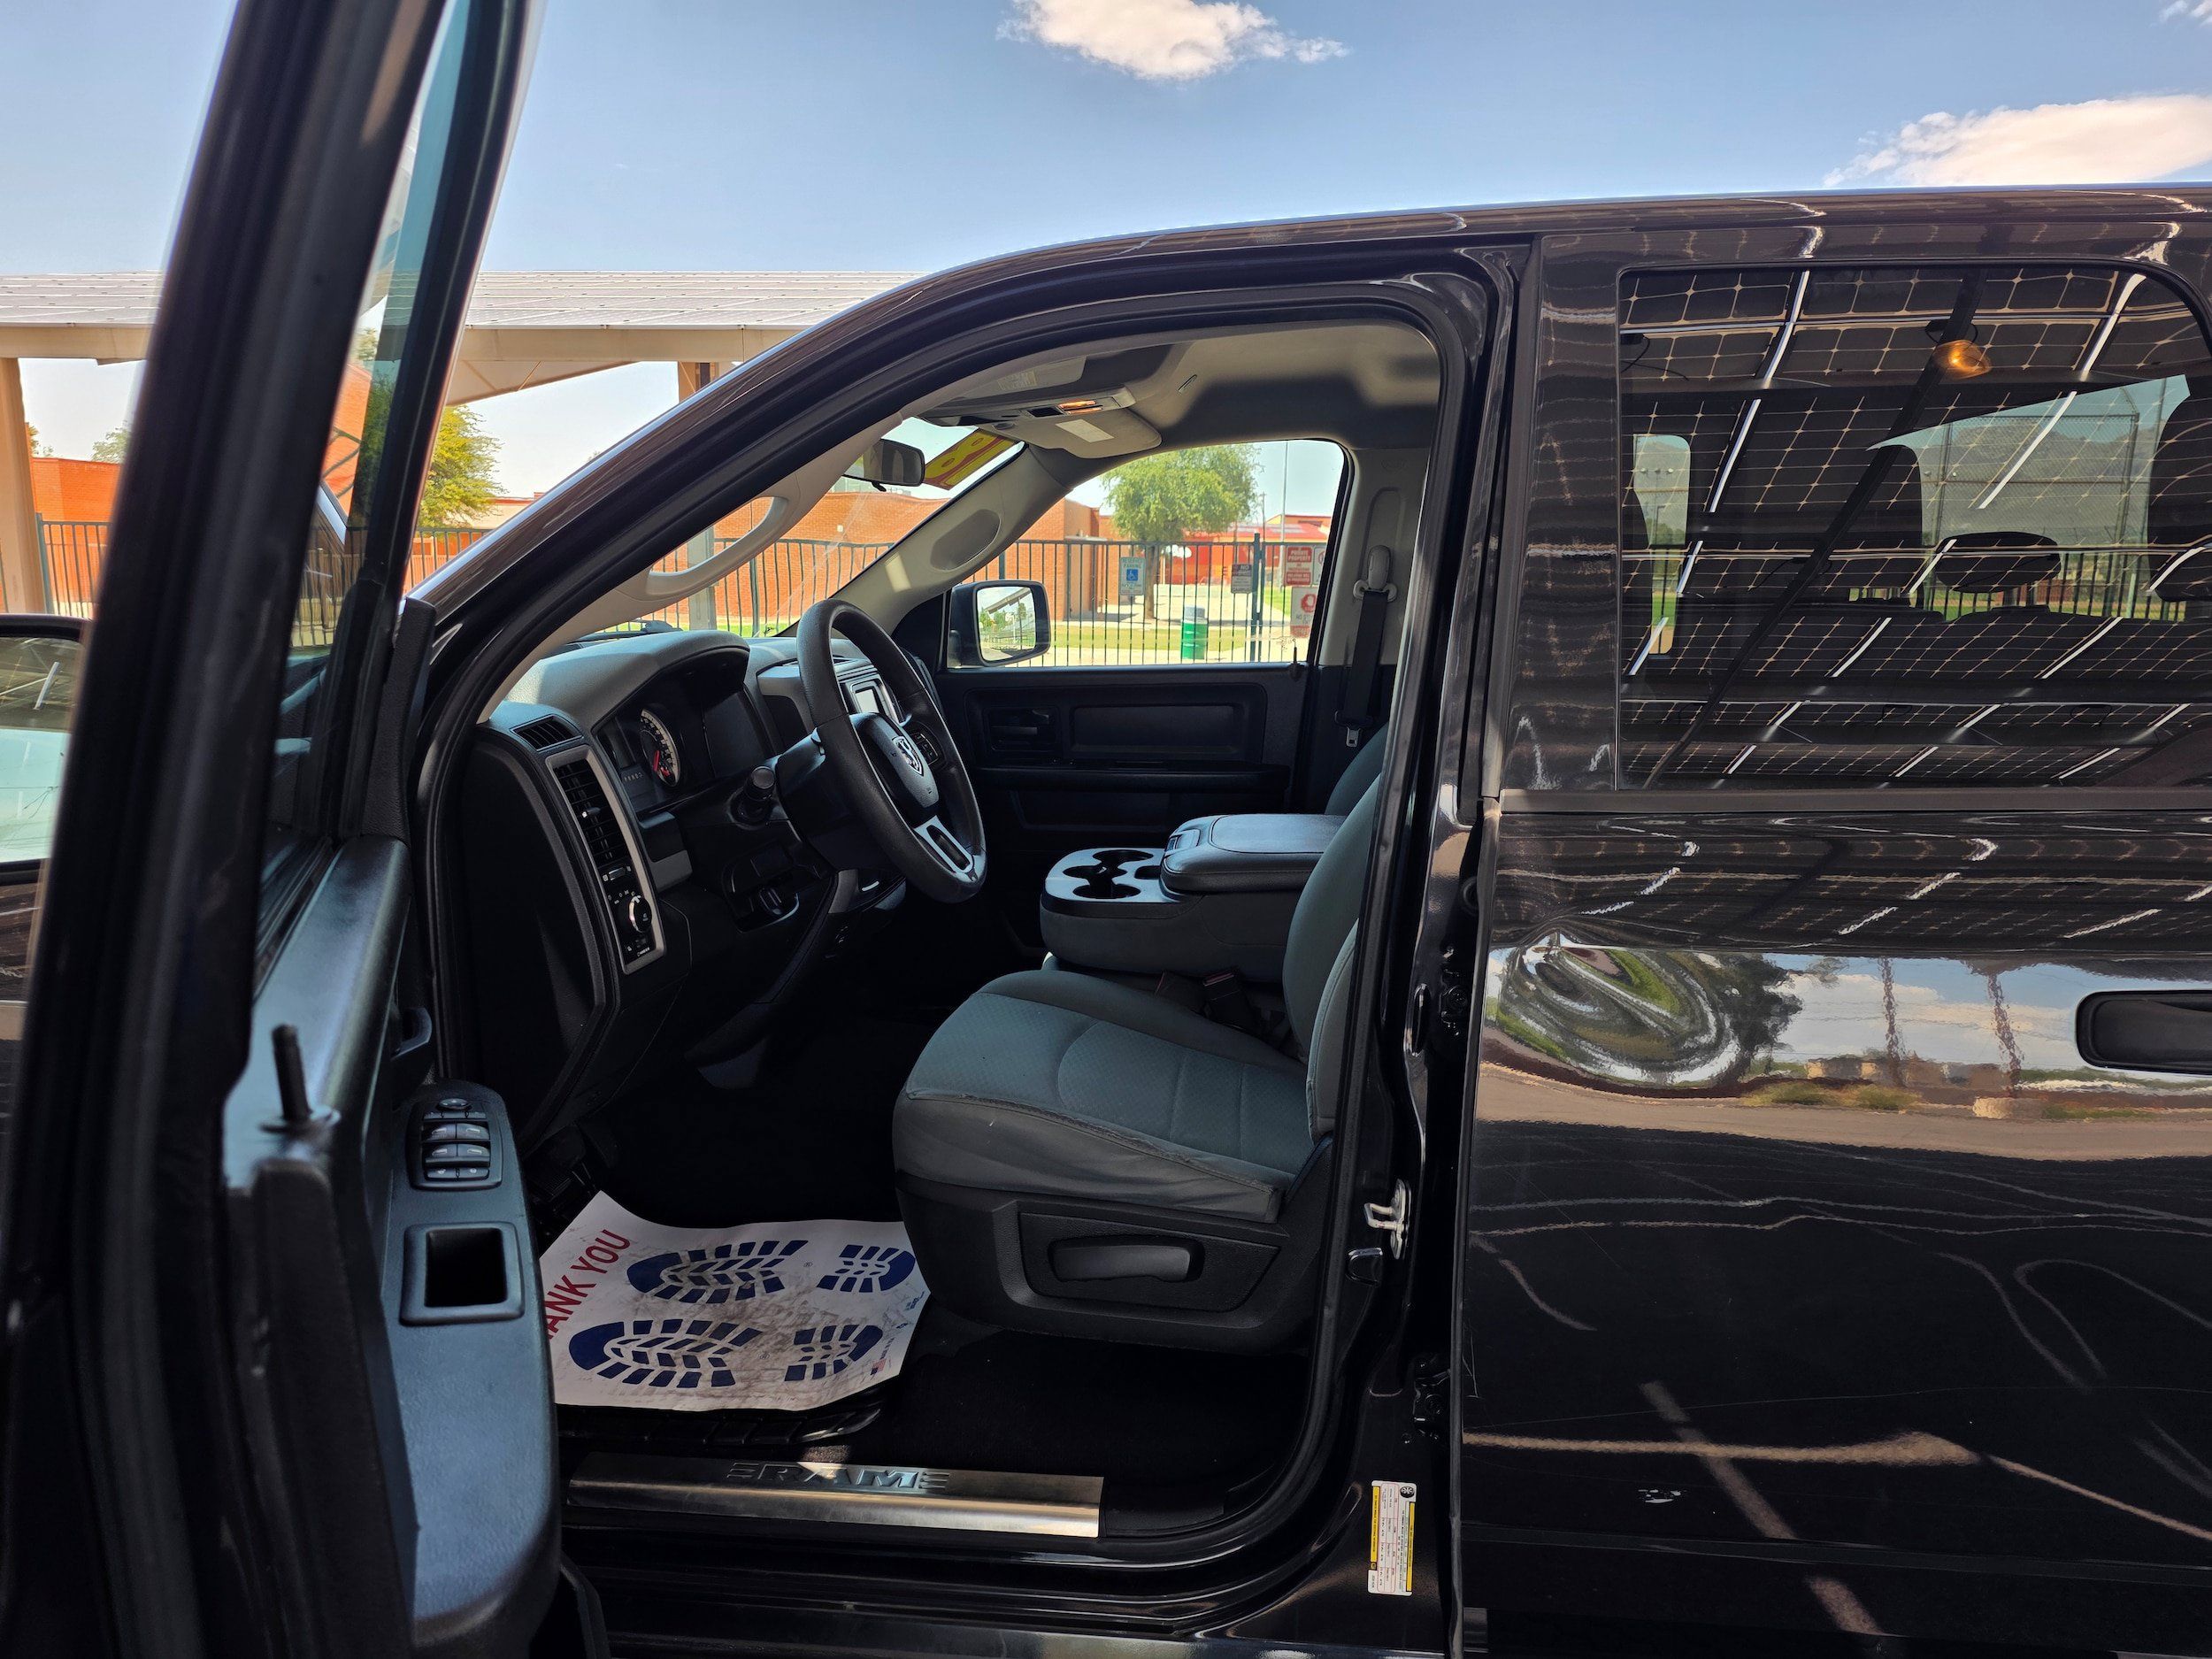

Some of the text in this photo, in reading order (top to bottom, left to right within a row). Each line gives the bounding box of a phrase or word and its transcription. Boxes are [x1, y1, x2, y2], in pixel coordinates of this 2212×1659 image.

[543, 1230, 631, 1340] ANK YOU
[757, 1463, 919, 1488] RAM
